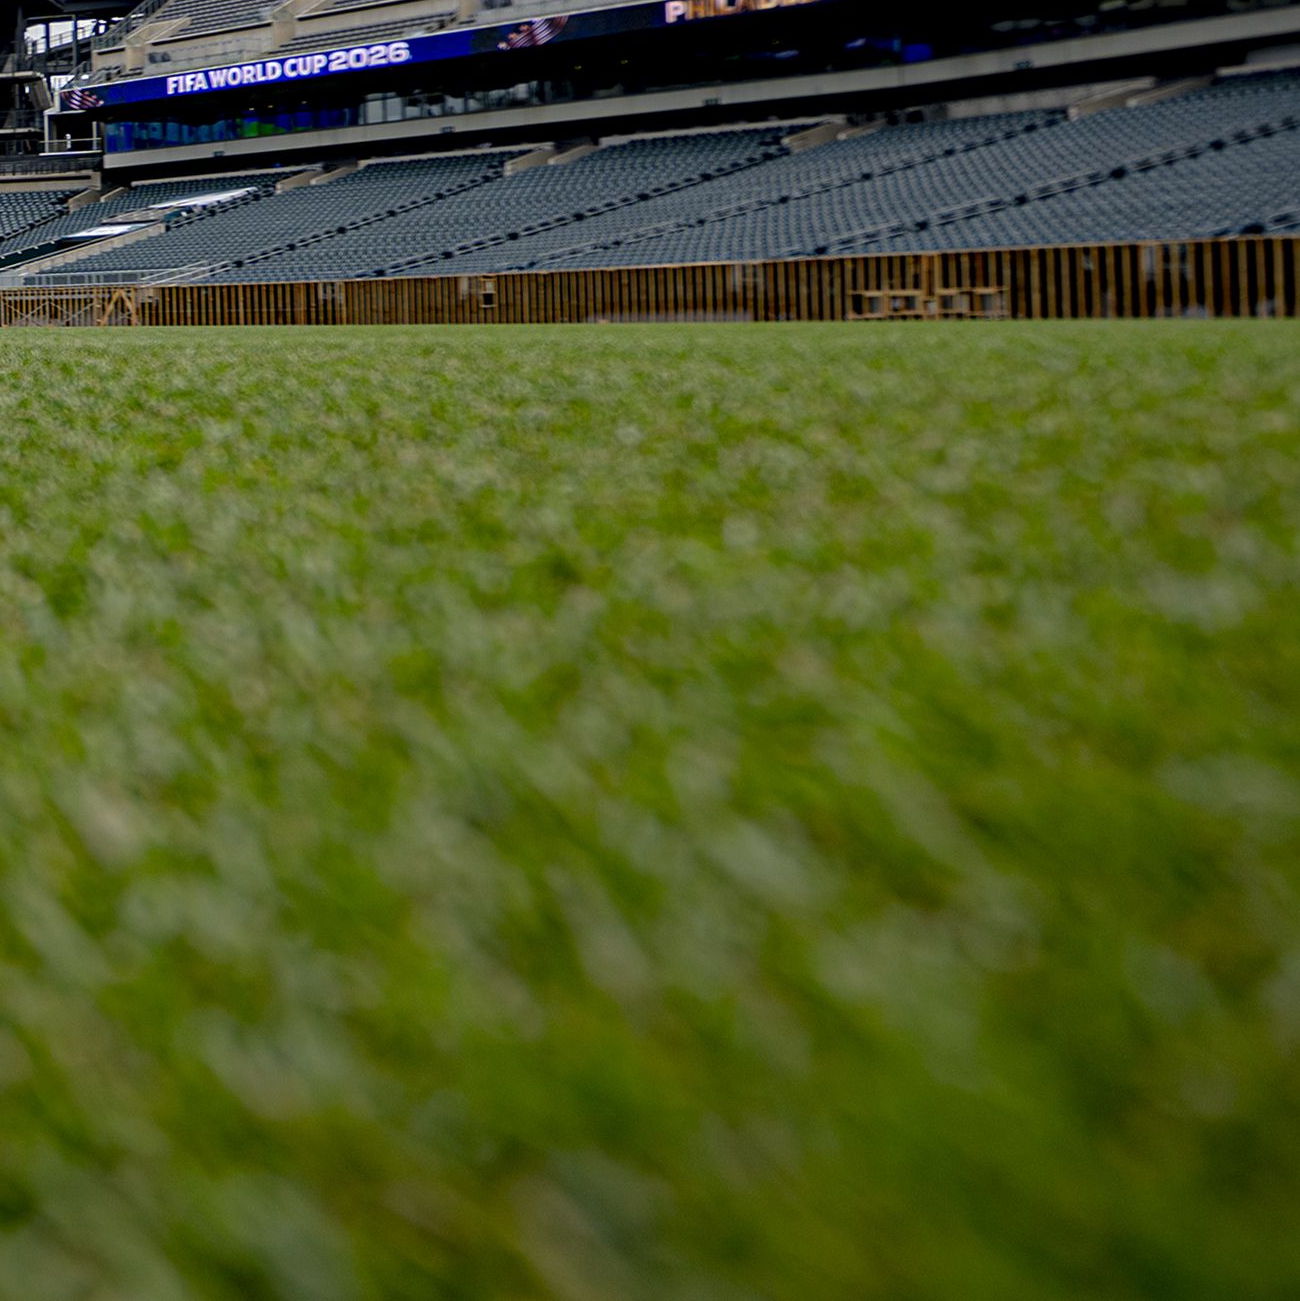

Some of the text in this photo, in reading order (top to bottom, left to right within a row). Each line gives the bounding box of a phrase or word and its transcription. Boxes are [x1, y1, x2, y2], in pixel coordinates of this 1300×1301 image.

[167, 42, 410, 95] FIFA WORLD CUP 2026
